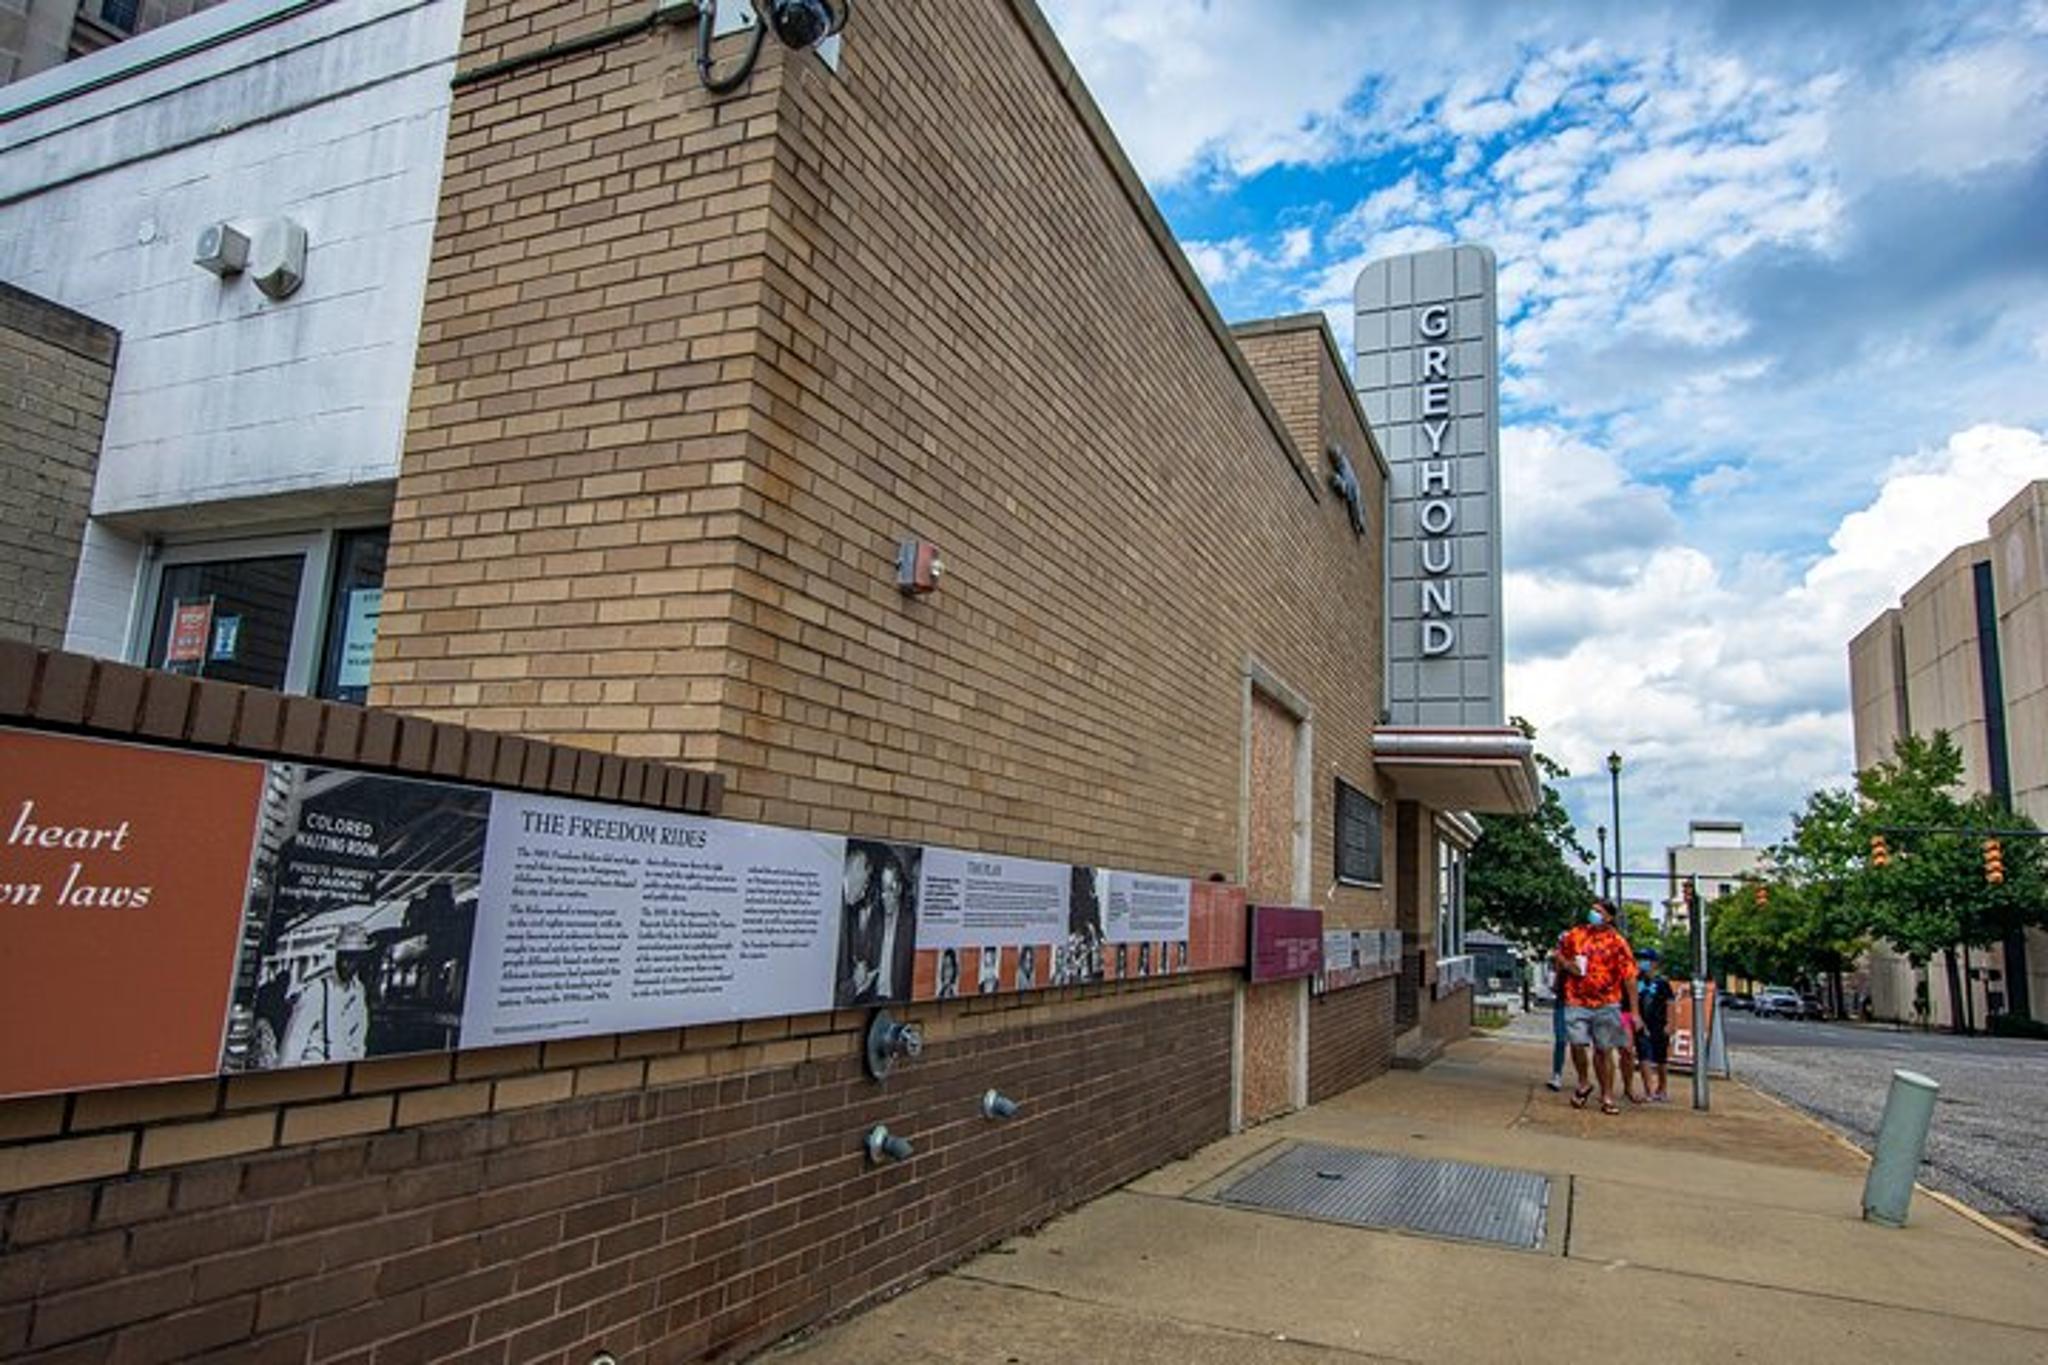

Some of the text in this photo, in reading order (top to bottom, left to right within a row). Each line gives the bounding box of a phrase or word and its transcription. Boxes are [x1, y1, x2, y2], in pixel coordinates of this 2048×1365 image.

[1420, 304, 1455, 657] GREYHOUND
[7, 799, 130, 852] heart
[295, 832, 379, 859] WAITING ROOM
[306, 812, 374, 839] COLORED
[522, 810, 707, 849] THE FREEDOM RIDES
[56, 861, 152, 909] laws
